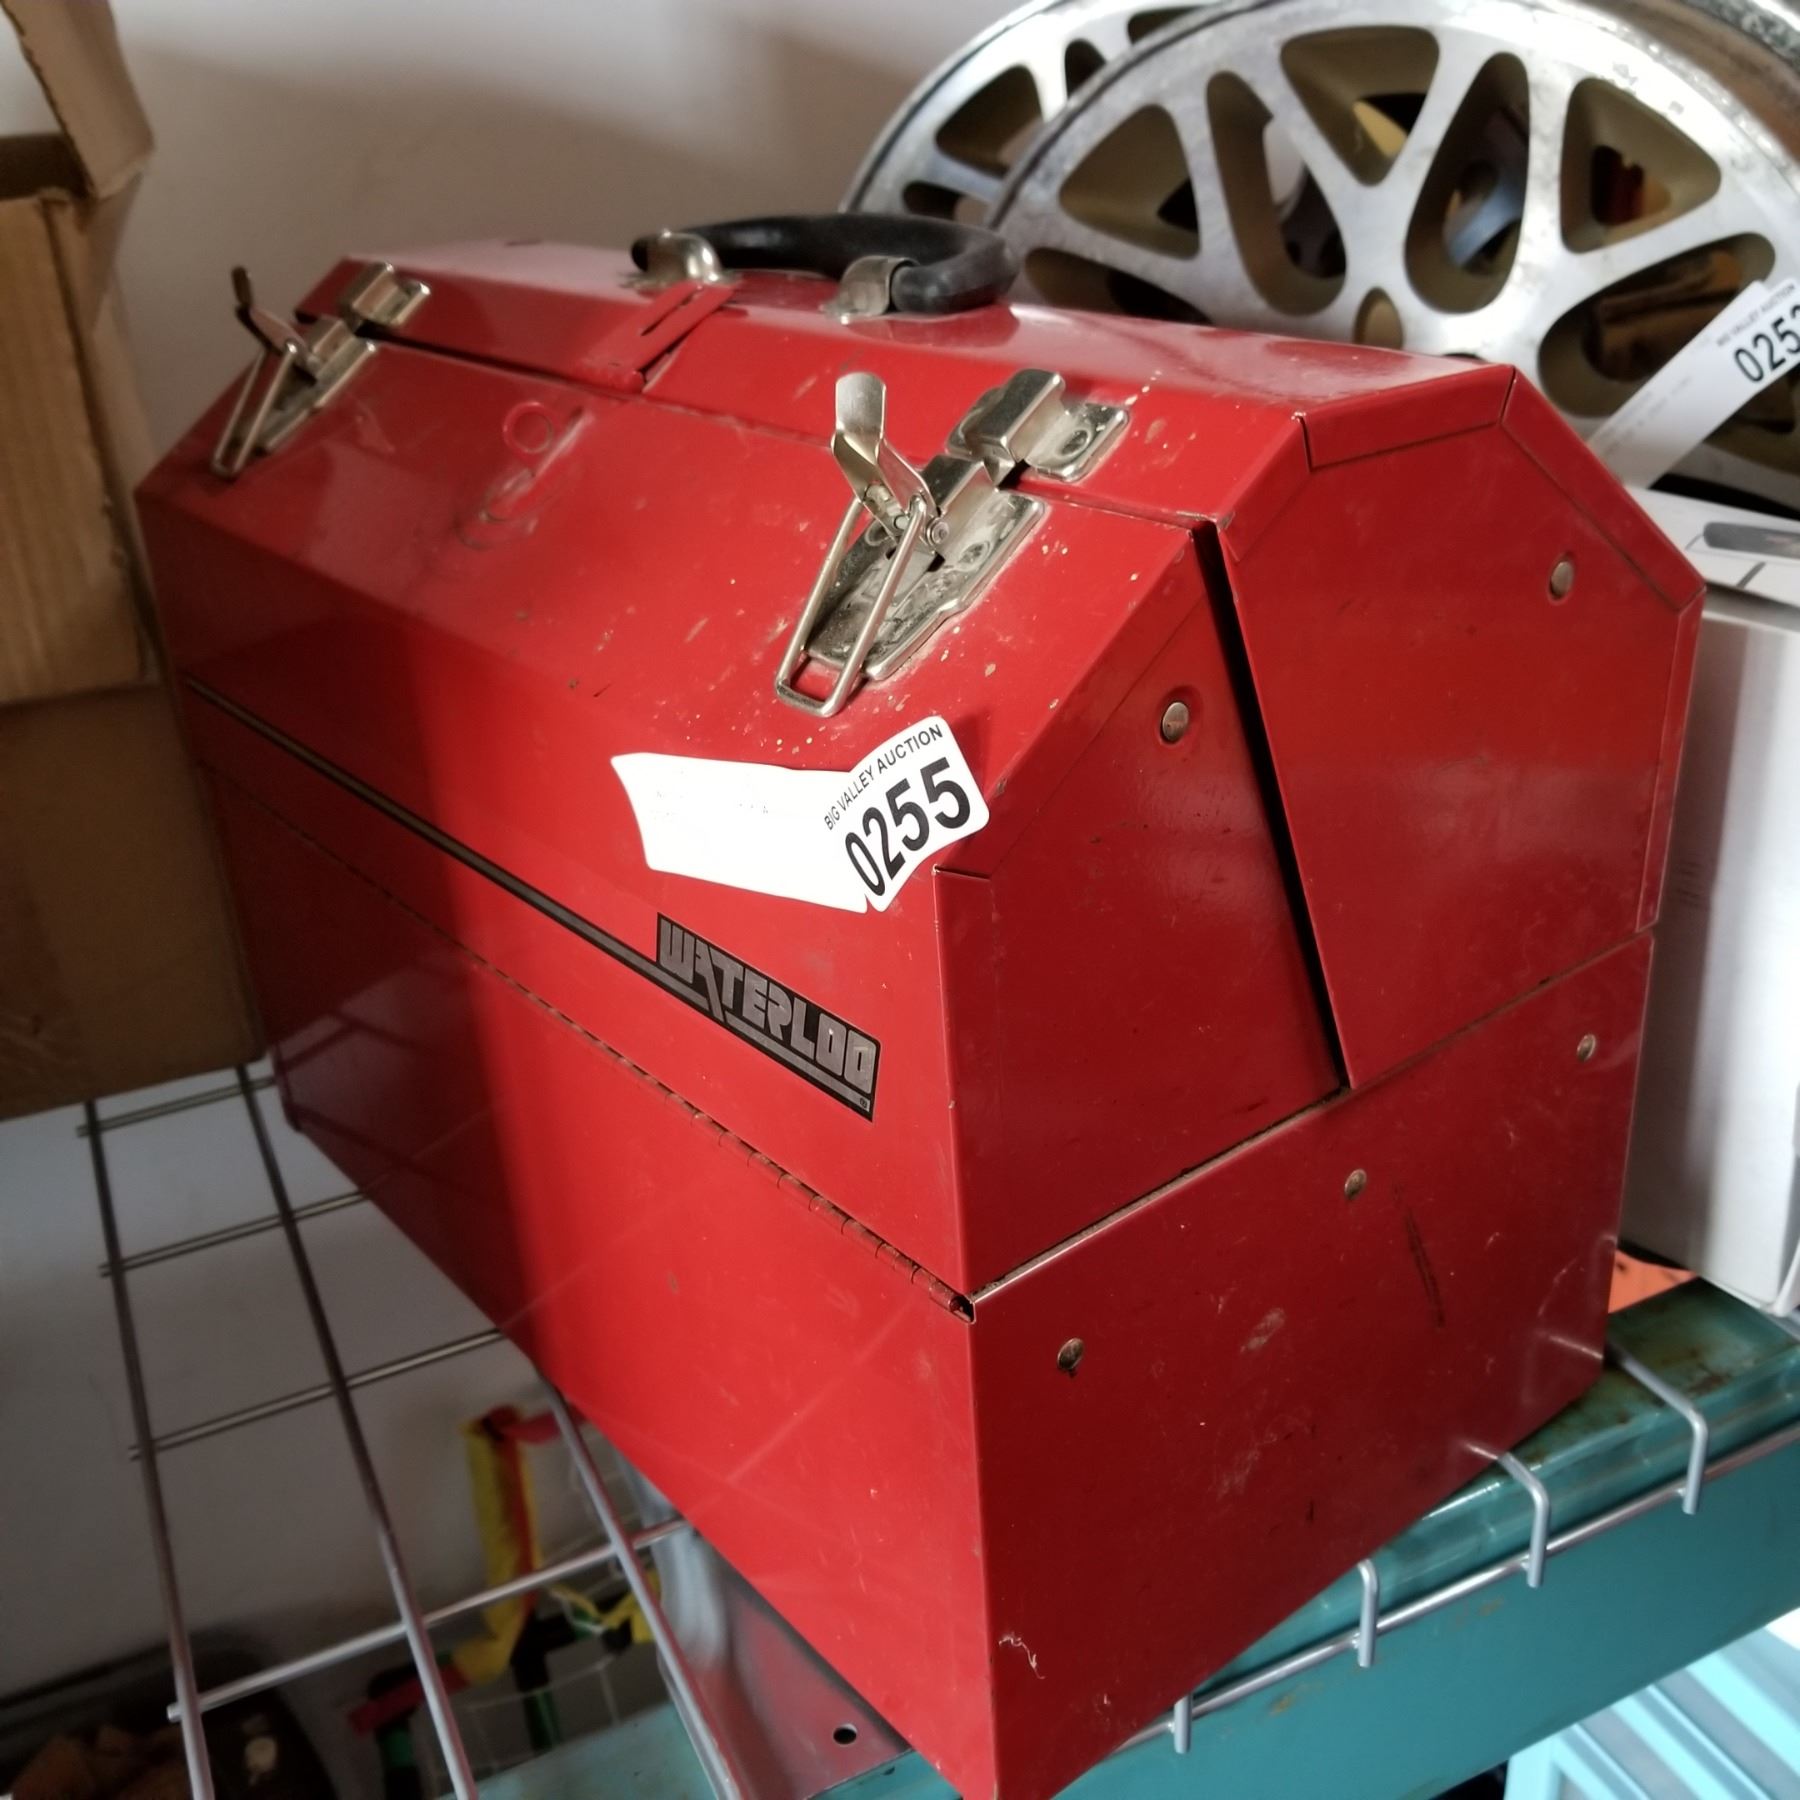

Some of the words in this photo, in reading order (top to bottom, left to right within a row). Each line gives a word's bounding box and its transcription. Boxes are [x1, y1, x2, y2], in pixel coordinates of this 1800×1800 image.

[1734, 304, 1800, 382] 025
[824, 805, 840, 830] BIG
[837, 765, 874, 811] VALLEY
[877, 724, 943, 774] AUCTION
[845, 757, 971, 896] 0255
[658, 915, 878, 1095] WATERLOO
